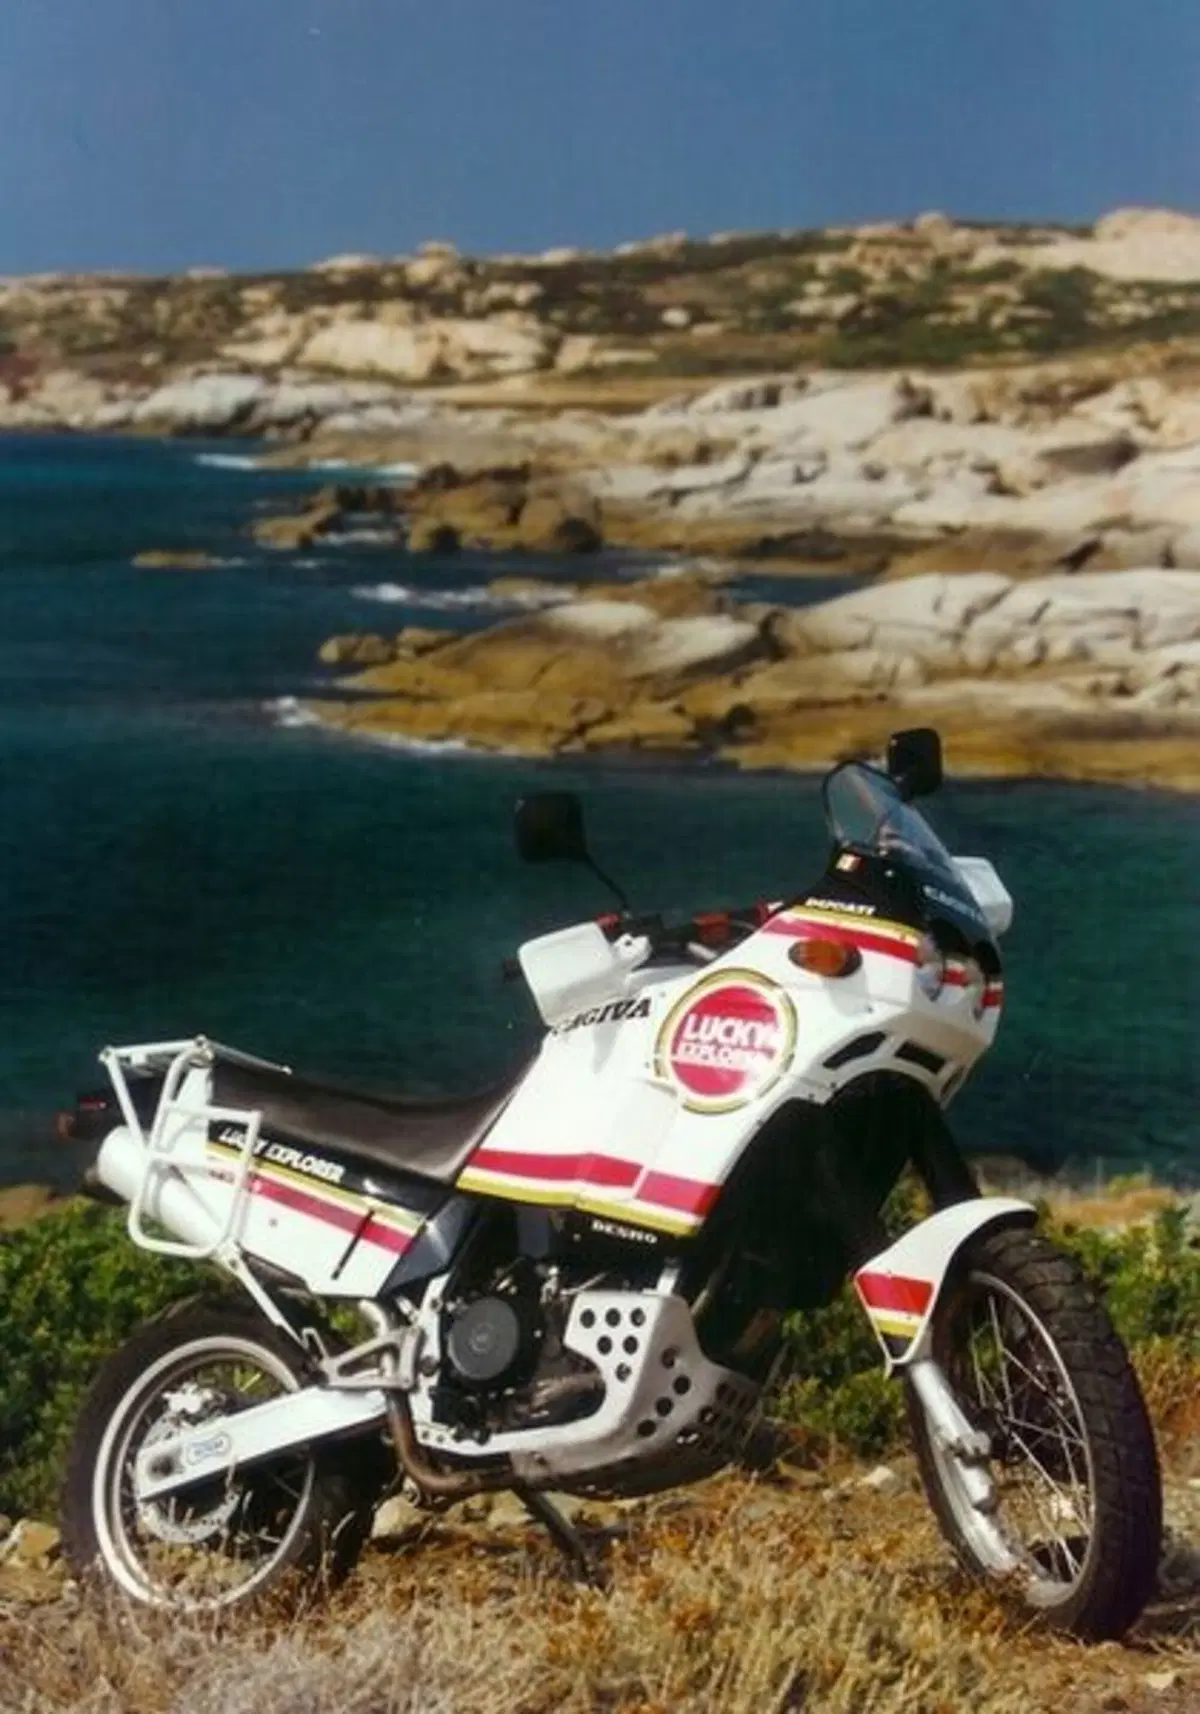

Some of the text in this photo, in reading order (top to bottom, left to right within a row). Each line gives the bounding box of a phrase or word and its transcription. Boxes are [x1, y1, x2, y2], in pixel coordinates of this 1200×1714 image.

[552, 997, 652, 1036] AGIVA
[682, 1013, 770, 1049] LUCKY
[675, 1041, 772, 1078] EXPLO
[219, 1127, 269, 1155] LUY
